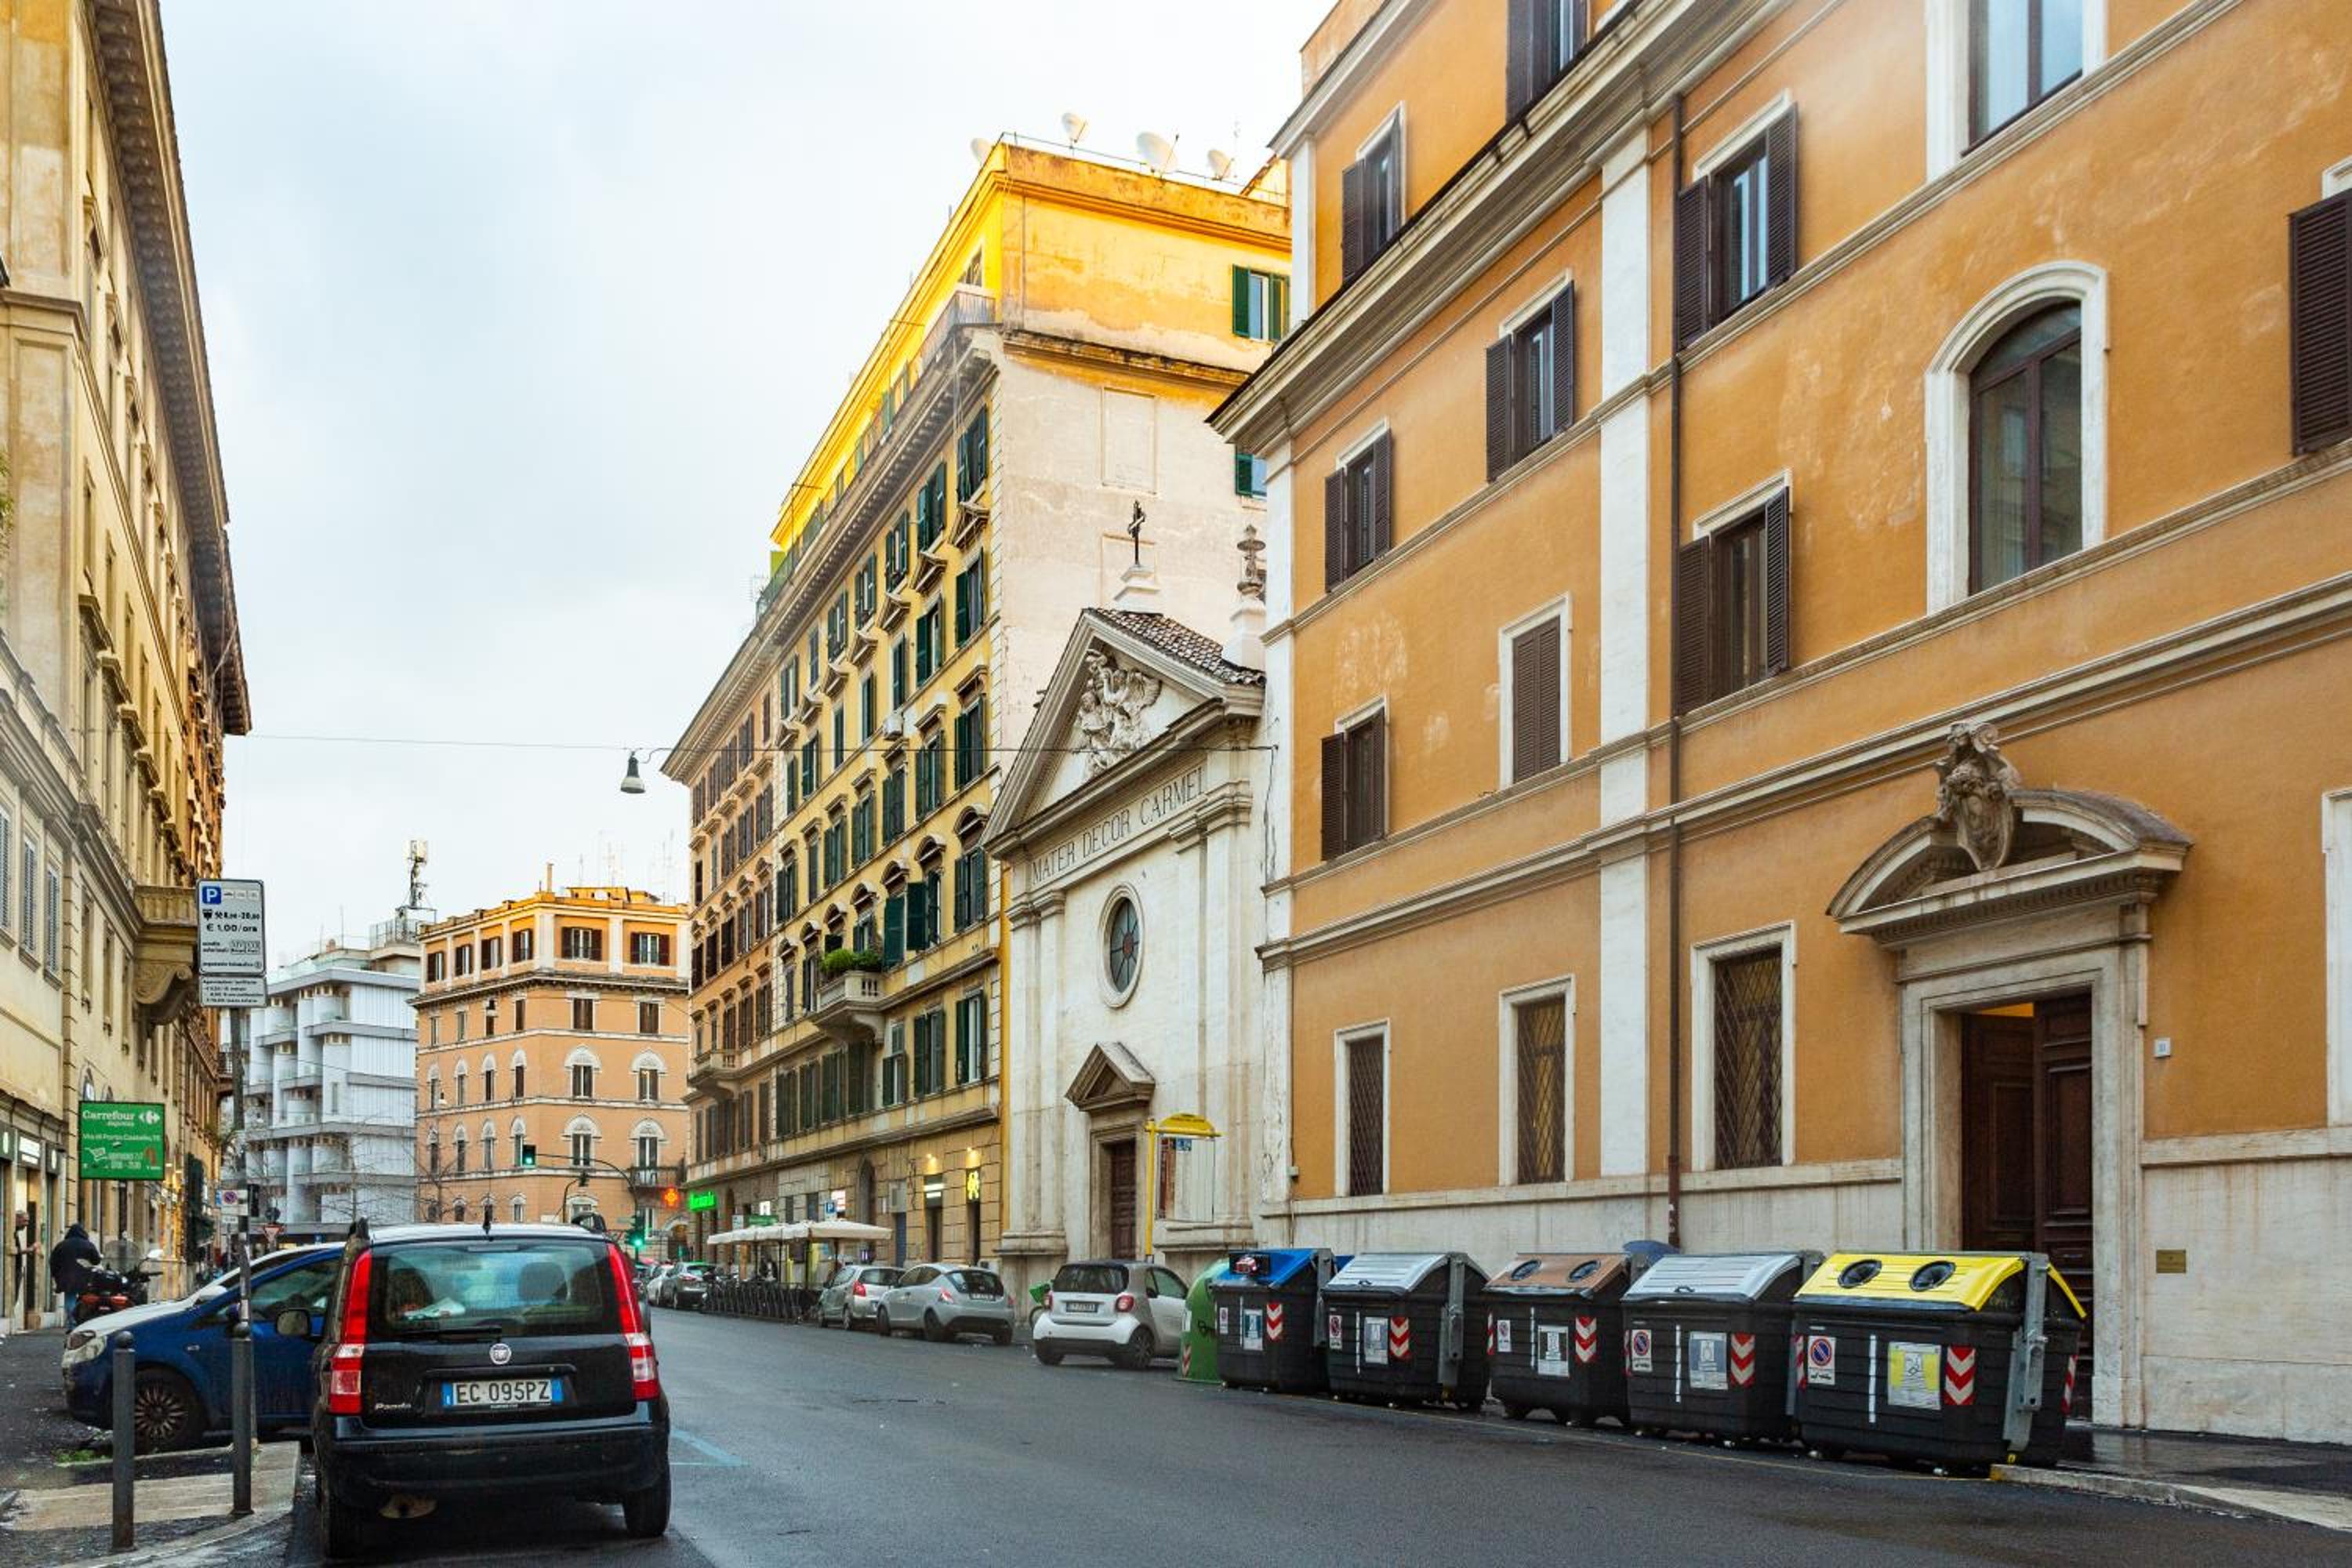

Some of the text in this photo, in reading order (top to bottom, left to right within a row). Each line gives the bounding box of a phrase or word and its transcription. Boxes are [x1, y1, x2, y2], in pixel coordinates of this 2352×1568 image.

[1032, 842, 1076, 885] MATER
[1082, 808, 1130, 858] DECOR
[206, 888, 218, 902] P
[82, 1109, 135, 1120] Carrefour
[456, 1381, 550, 1404] EC 095PZ
